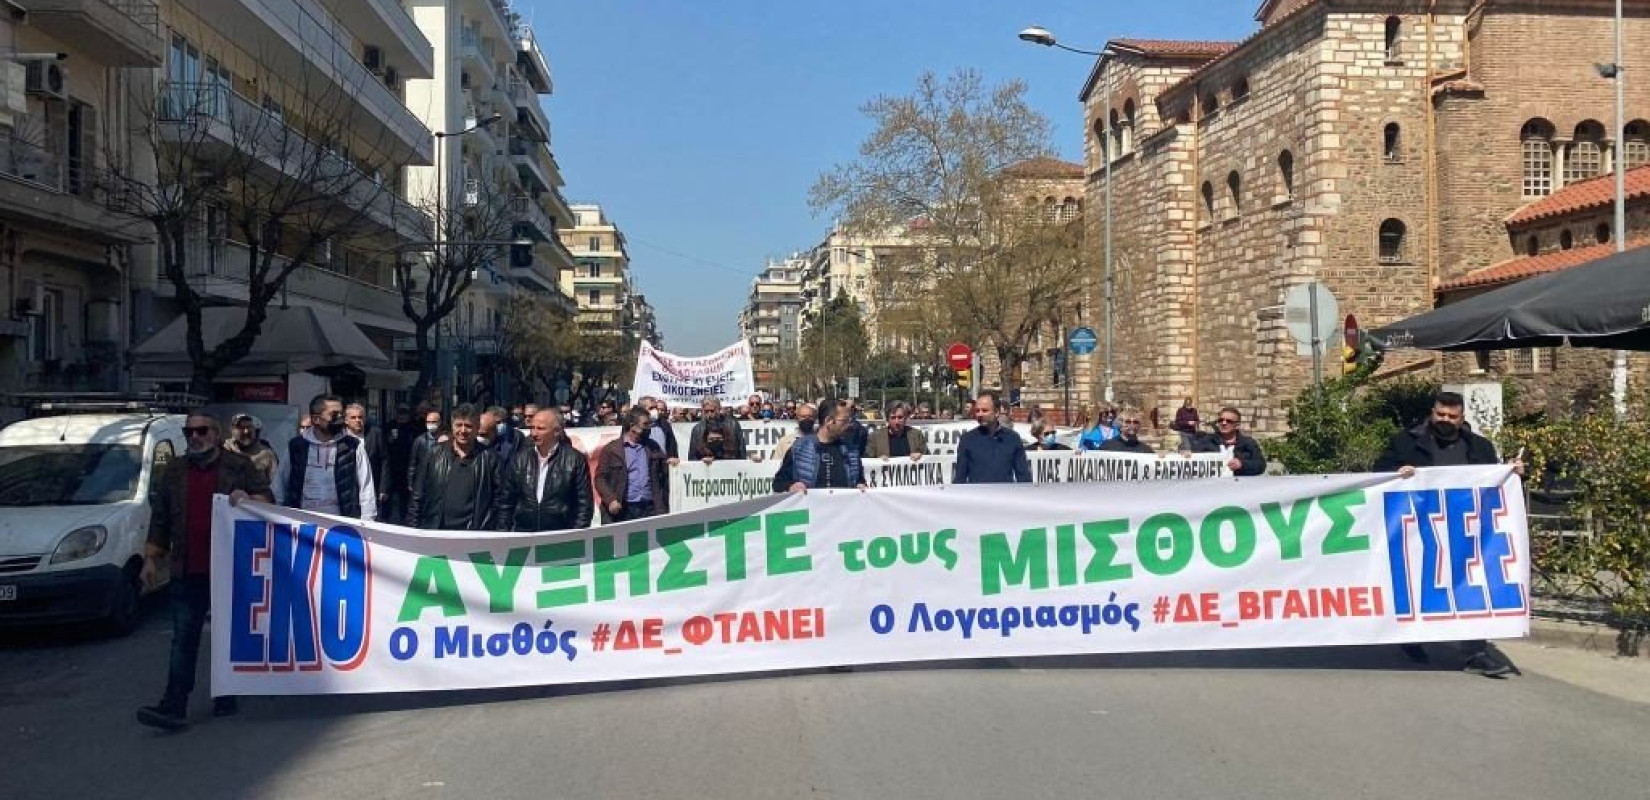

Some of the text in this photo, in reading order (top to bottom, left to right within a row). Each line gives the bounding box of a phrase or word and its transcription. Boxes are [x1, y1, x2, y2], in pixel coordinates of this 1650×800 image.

[661, 384, 727, 396] ΟΙΚΟΓΕΝΕΙΕΣ
[741, 427, 786, 446] ΤΗΝ
[881, 462, 944, 488] ΣΥΛΛΟΓΙΚΑ
[1036, 458, 1061, 483] ΜΑΣ
[1067, 457, 1138, 483] ΔΙΚΑΙΩΜΑΤΑ
[398, 490, 1370, 623] ΑΥΞΗΣΤΕ τους ΜΙΣΘΟΥΣ
[1383, 486, 1528, 622] ΓΣΕΕ
[229, 519, 373, 672] ΕΚΘ
[870, 586, 1385, 639] Ο Λογαριασμός #ΔΕ_ΒΓΑΙΝΕΙ
[389, 608, 826, 662] Ο Μισθός #ΔΕ_ΦΤΑΝΕΙ
